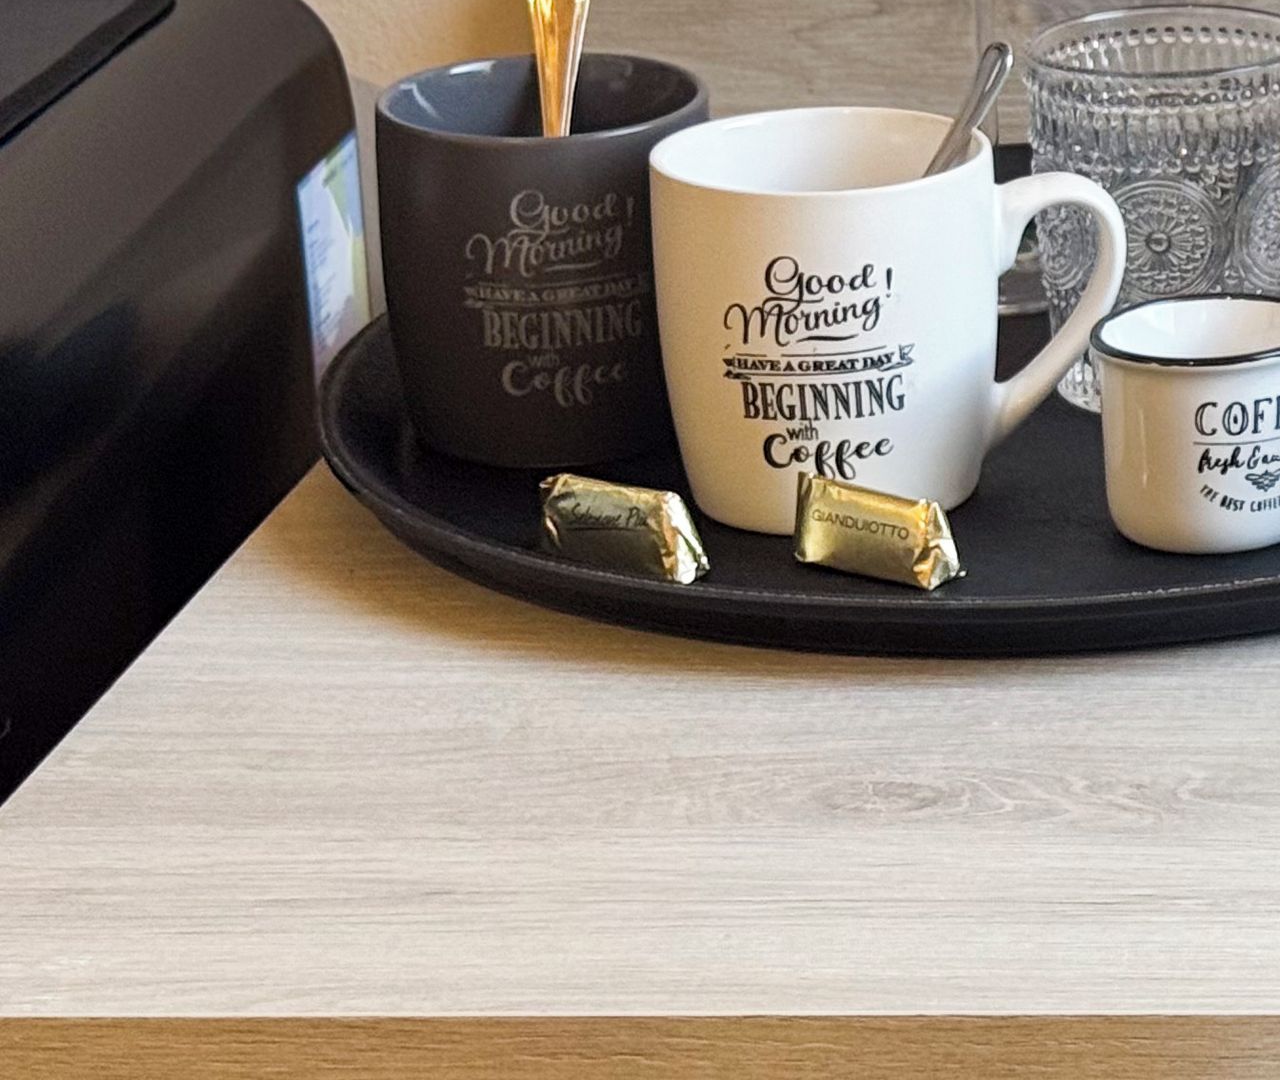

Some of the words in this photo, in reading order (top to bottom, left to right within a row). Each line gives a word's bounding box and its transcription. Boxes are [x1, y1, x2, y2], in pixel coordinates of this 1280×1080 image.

[465, 225, 624, 277] Morning
[482, 299, 642, 349] BEGINNING
[723, 296, 882, 347] Morning
[528, 350, 560, 367] with
[737, 358, 781, 371] HAVE
[782, 358, 795, 372] A
[798, 357, 860, 372] GREAT
[863, 351, 896, 370] DAY
[502, 361, 626, 407] Coffee
[741, 374, 906, 421] BEGINNING
[786, 421, 818, 441] with
[763, 433, 894, 480] Coffee
[812, 509, 910, 540] GIANDUIOTTO
[1220, 495, 1246, 512] BEST
